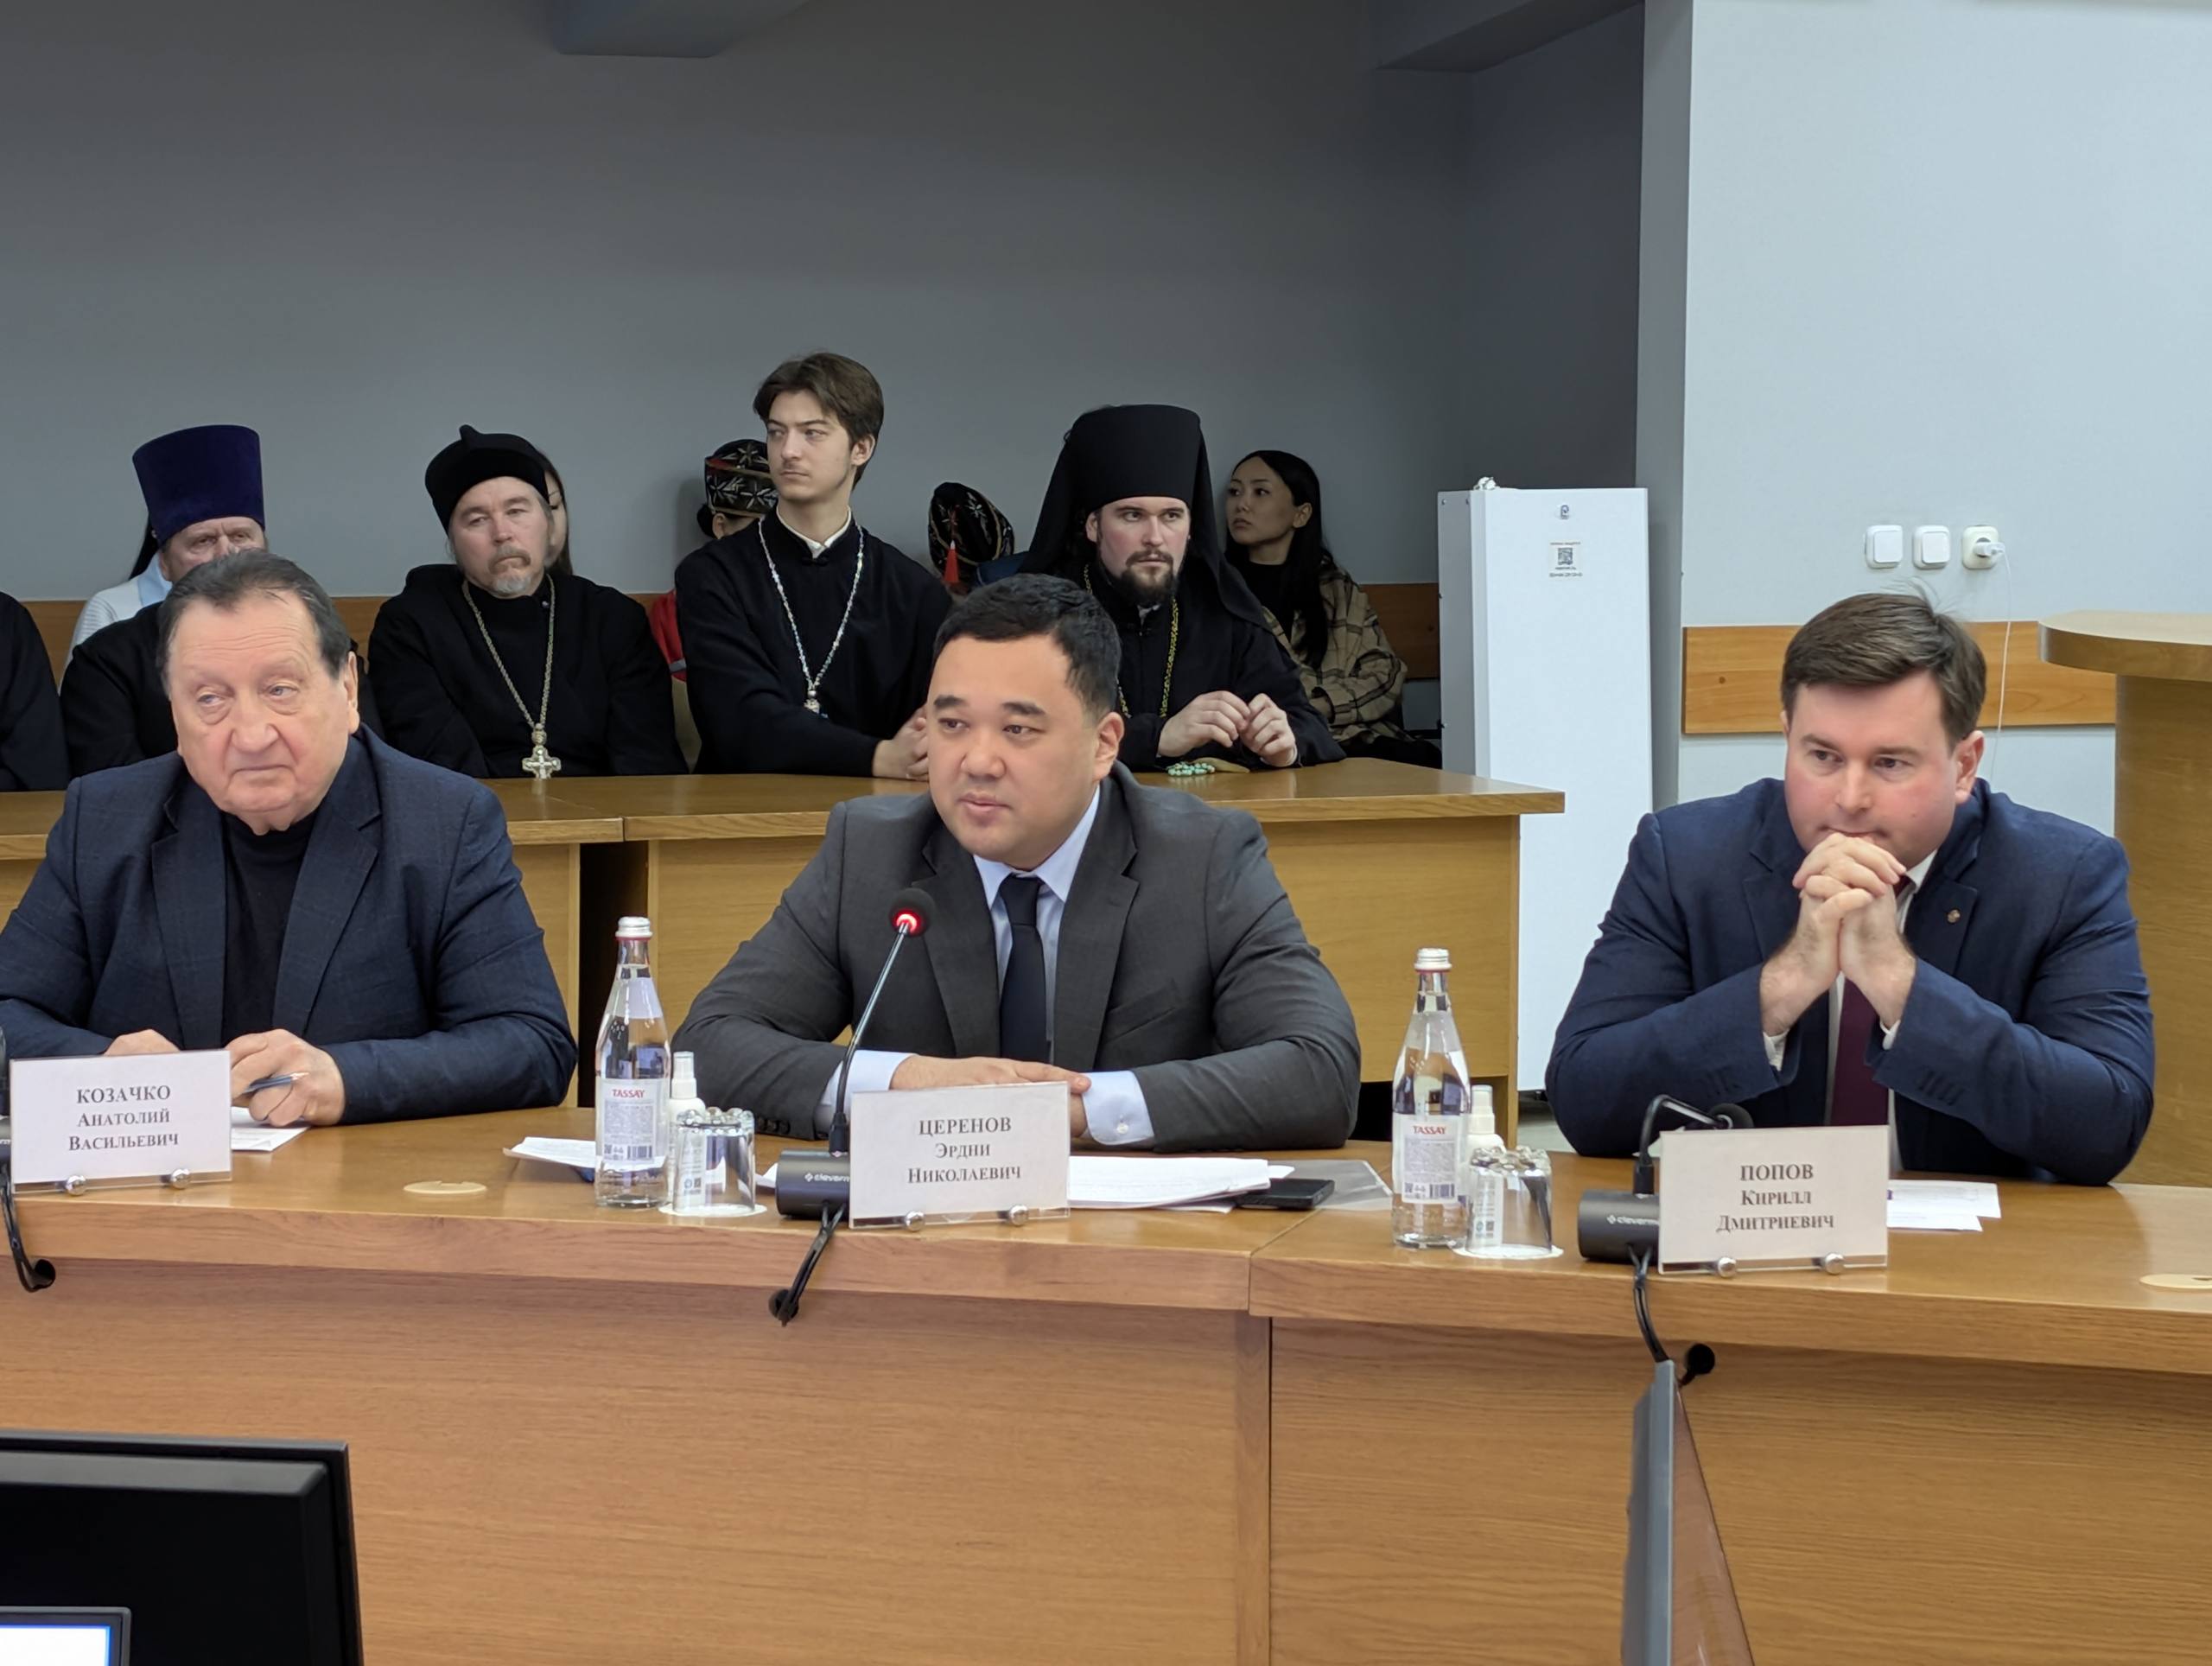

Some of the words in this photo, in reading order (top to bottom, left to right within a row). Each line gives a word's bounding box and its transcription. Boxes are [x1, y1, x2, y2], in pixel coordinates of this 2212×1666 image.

[77, 1084, 171, 1104] КОЗАЧКО
[612, 1089, 645, 1098] TASSAY
[918, 1116, 1012, 1137] ЦЕРЕНОВ
[1413, 1125, 1447, 1135] TASSAY
[1740, 1164, 1814, 1181] ПОПОВ
